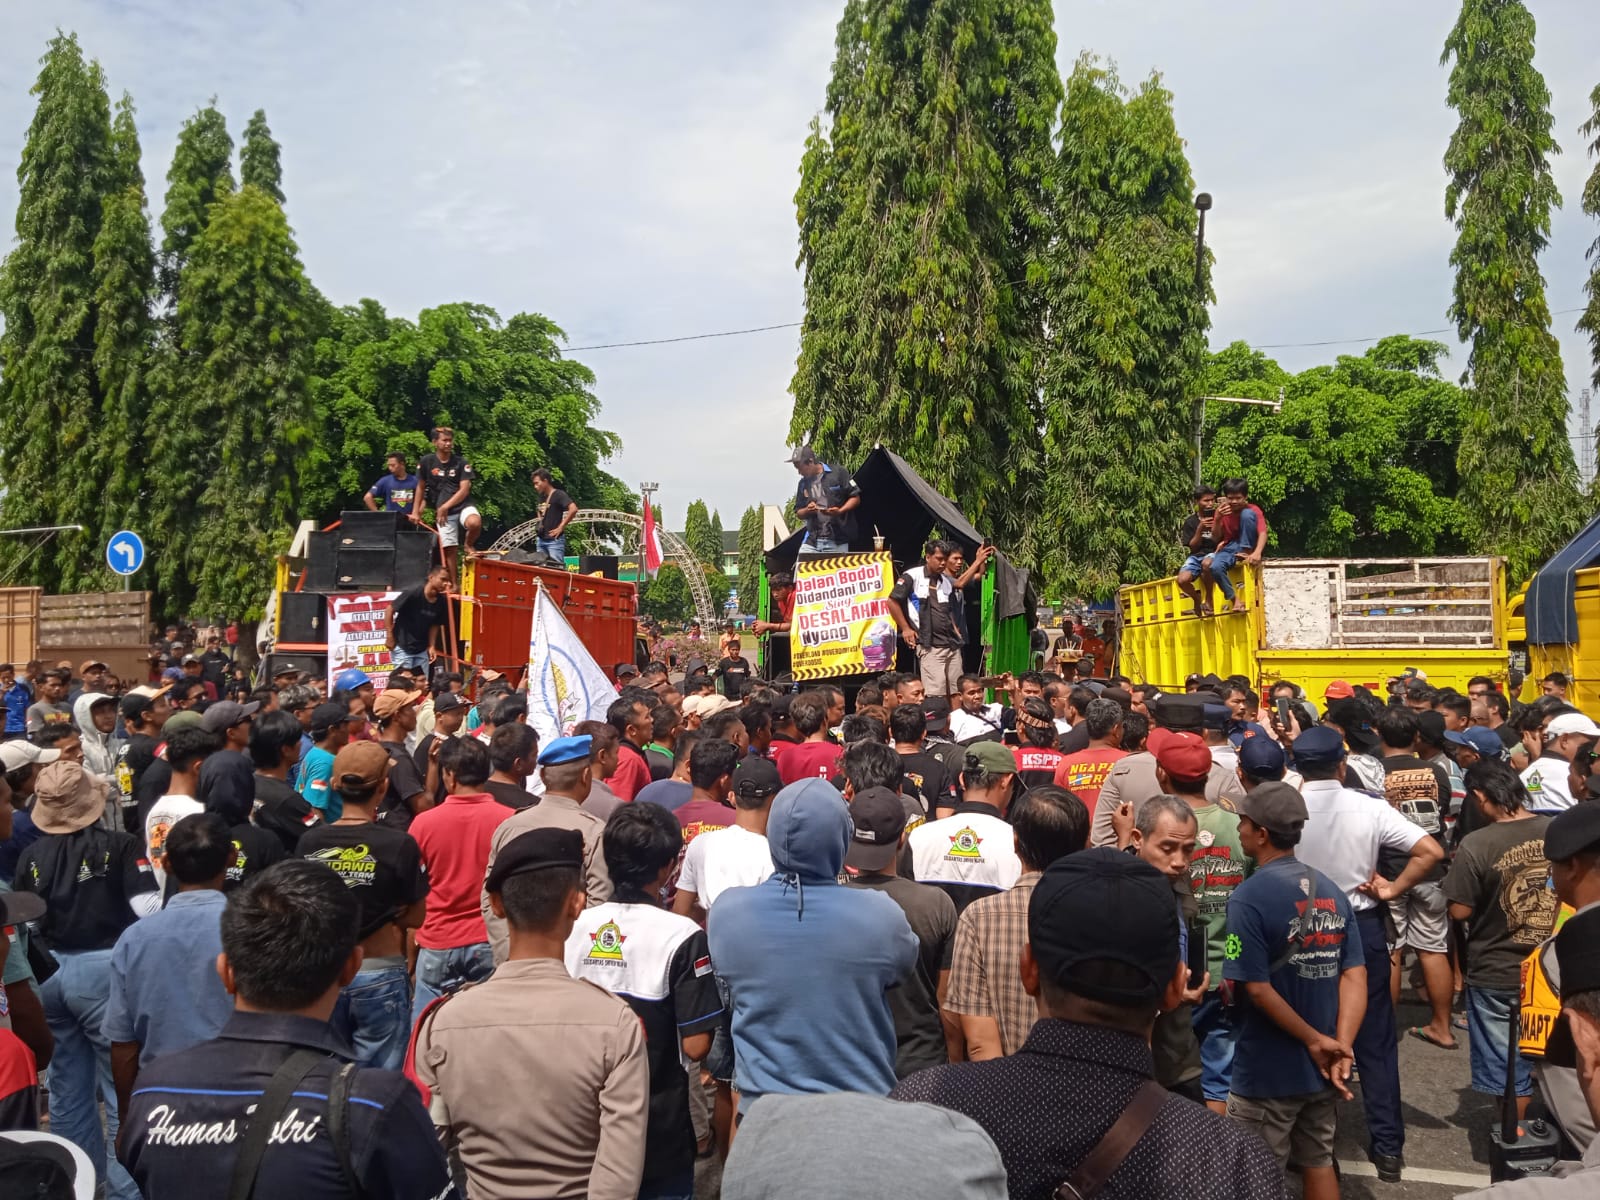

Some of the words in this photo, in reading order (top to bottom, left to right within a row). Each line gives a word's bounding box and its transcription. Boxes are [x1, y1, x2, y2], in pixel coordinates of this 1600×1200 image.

[796, 575, 835, 592] Dalan
[838, 564, 880, 585] Bodol
[796, 583, 856, 605] Didandani
[860, 579, 881, 593] Ora
[802, 625, 849, 645] Nyong
[1069, 762, 1115, 774] NGAPA
[1520, 1012, 1553, 1042] MAPT
[147, 1104, 238, 1147] Humas
[246, 1104, 321, 1145] olri
